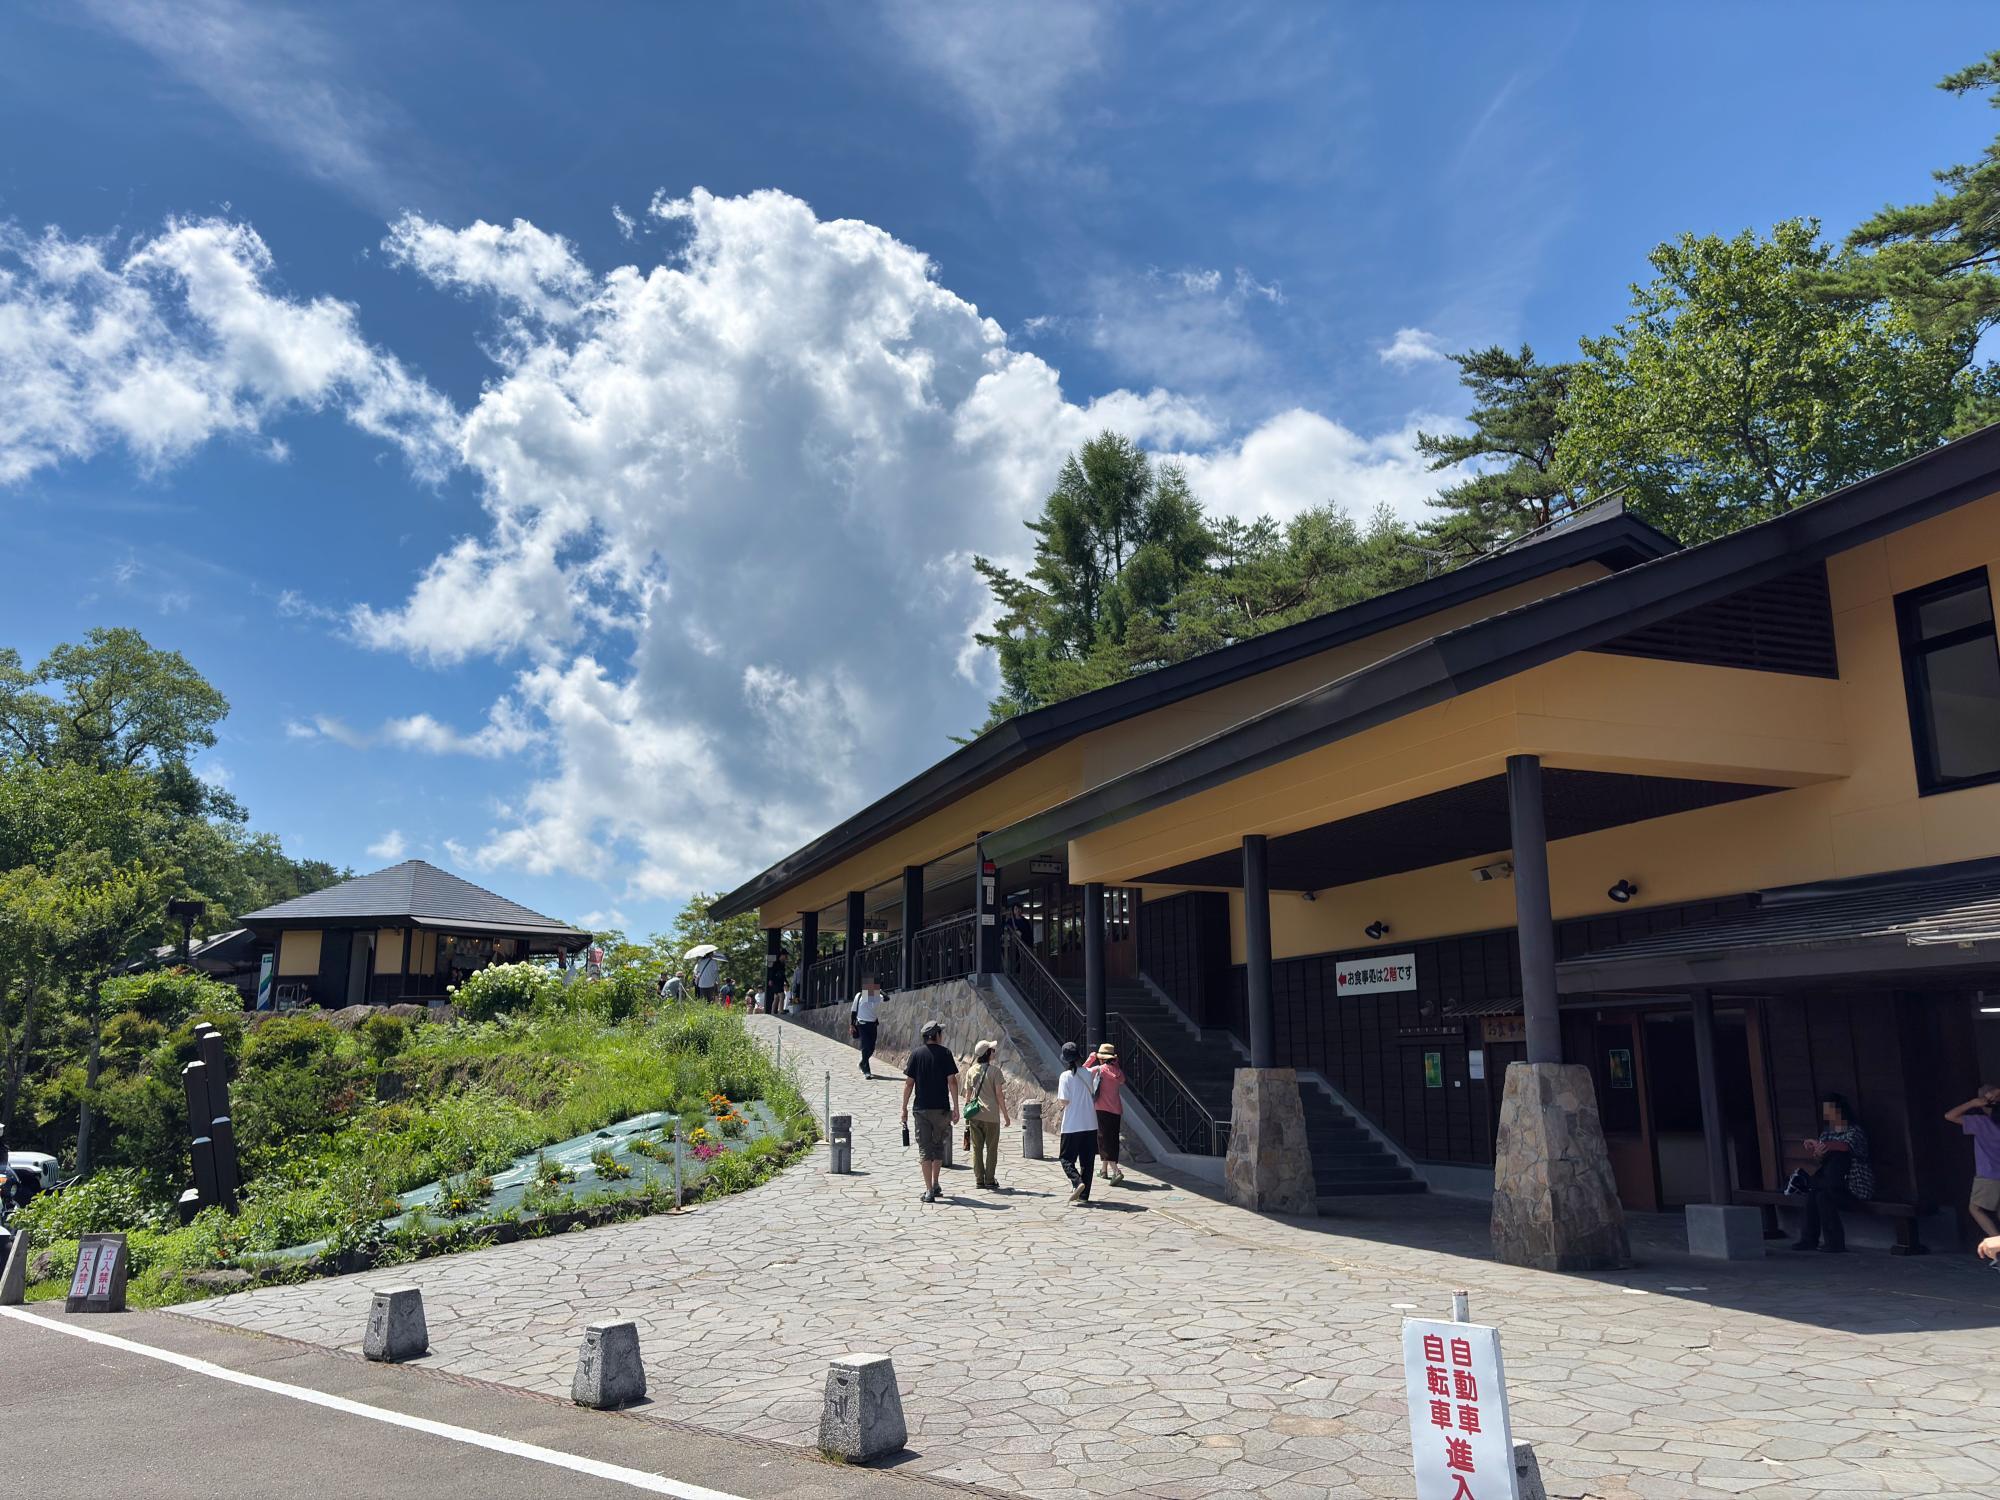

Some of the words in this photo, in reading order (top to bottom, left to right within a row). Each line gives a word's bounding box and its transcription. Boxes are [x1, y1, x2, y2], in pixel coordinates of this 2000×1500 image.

[1347, 966, 1412, 985] お食事処は2階です
[74, 1249, 94, 1295] 立入禁止
[97, 1249, 114, 1295] 立入禁止
[1423, 1334, 1453, 1430] 自転車
[1450, 1337, 1482, 1435] 自動車
